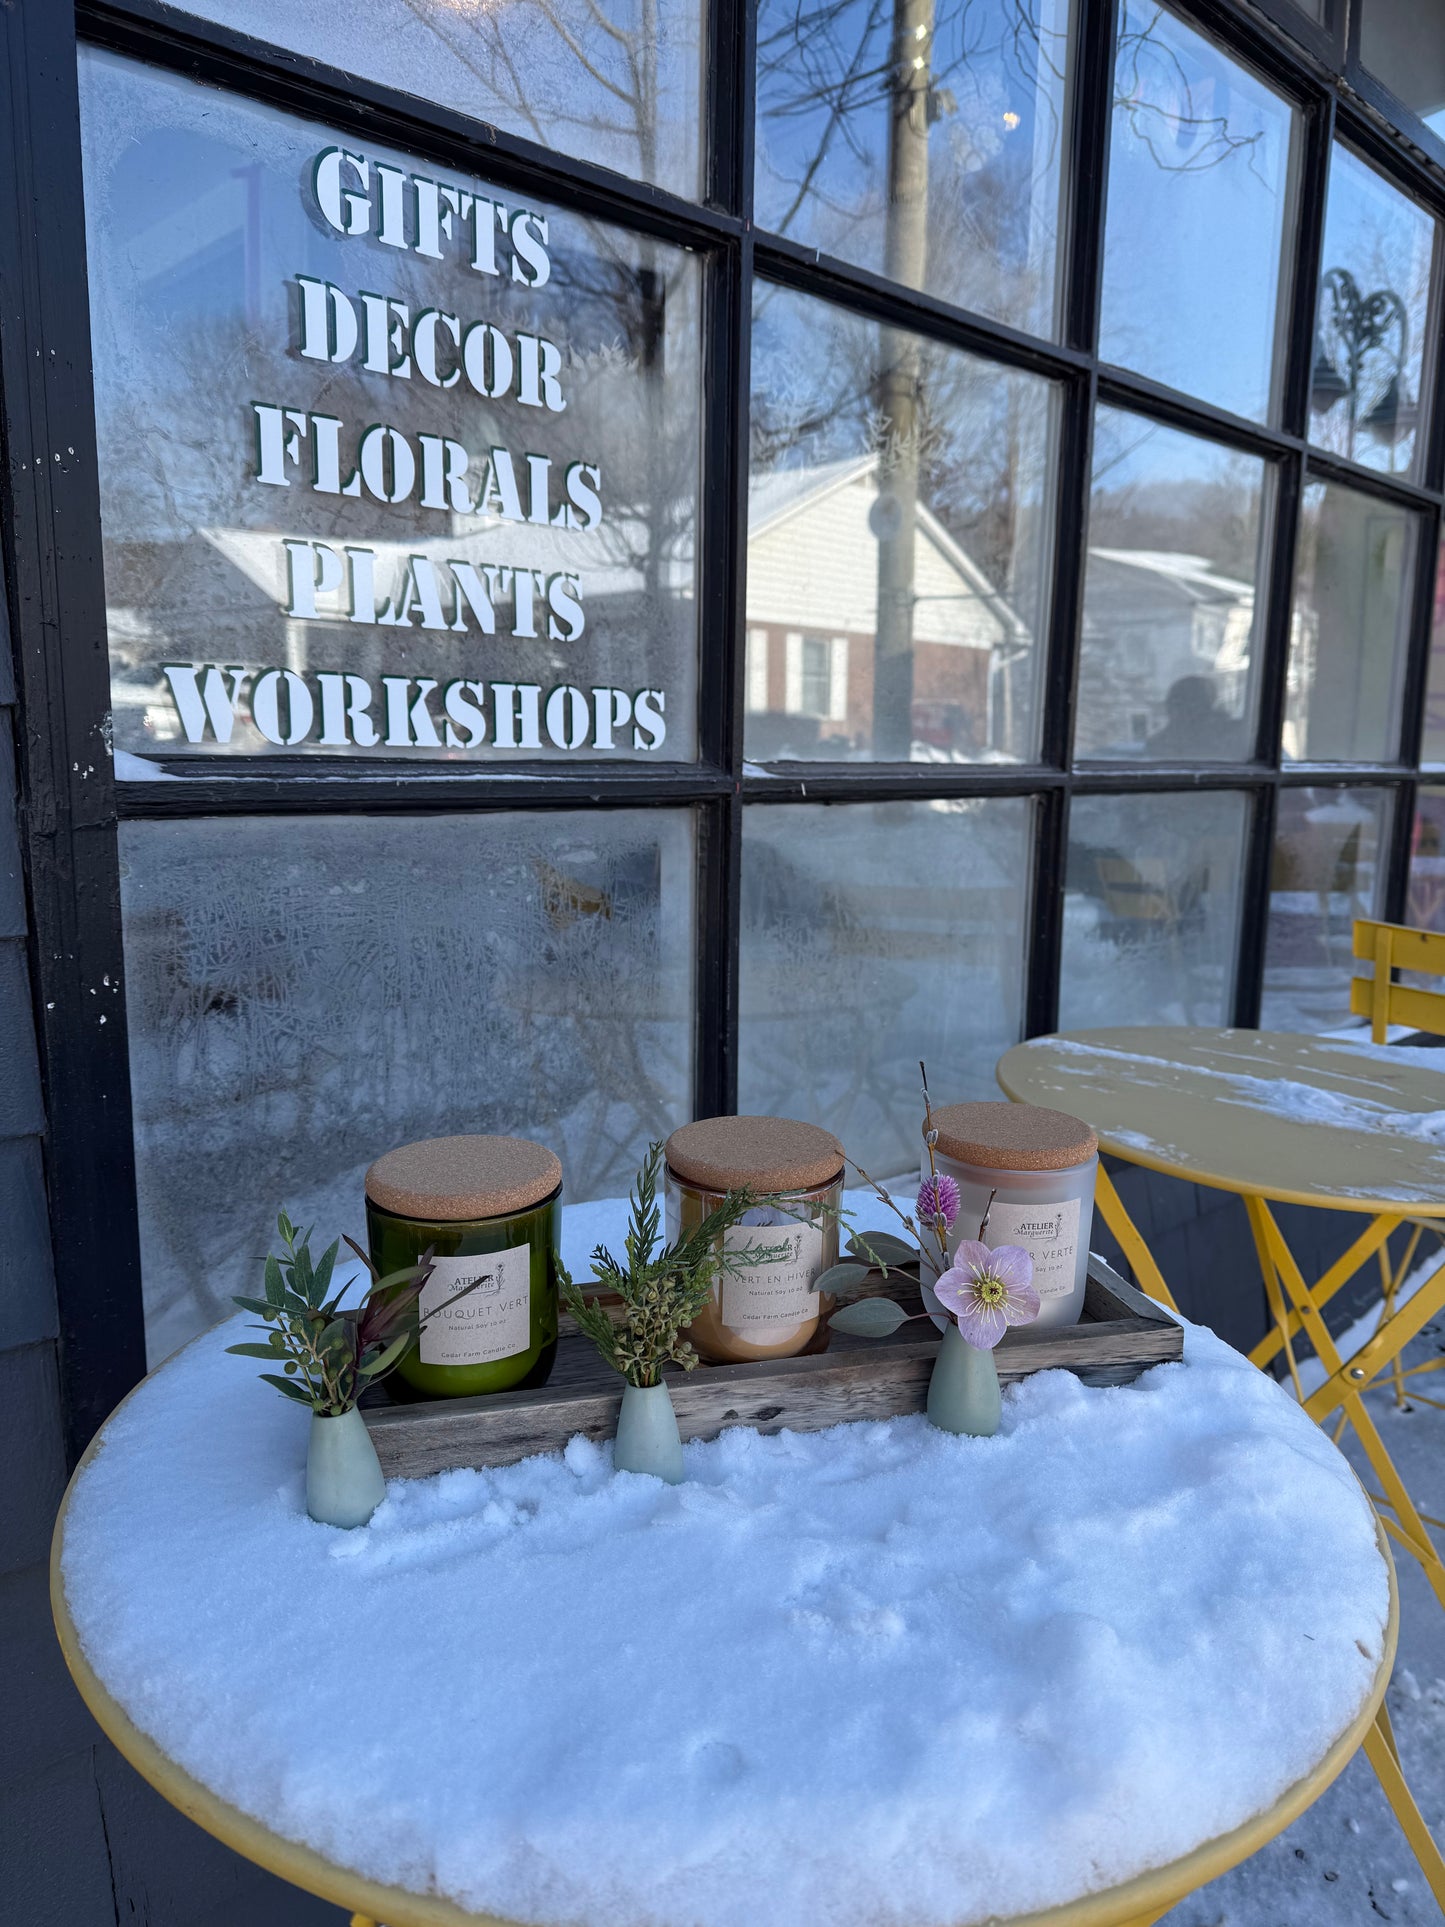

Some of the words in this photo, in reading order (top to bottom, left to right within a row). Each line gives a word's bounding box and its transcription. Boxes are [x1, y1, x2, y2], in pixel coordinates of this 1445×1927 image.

[313, 146, 550, 288] GIFTS
[295, 275, 567, 413] DECOR
[251, 401, 602, 532] FLORALS
[282, 539, 584, 643] PLANTS
[161, 663, 667, 751] WORKSHOPS
[1020, 1222, 1054, 1230] ATELIER
[1042, 1245, 1073, 1260] VERTE
[733, 1275, 760, 1284] VERT
[767, 1275, 781, 1284] EN
[787, 1267, 815, 1281] HIVER
[423, 1306, 492, 1320] BOUQUET
[499, 1295, 528, 1312] VERT
[448, 1323, 474, 1331] Natural
[476, 1322, 488, 1330] Soy
[483, 1346, 506, 1355] Candle
